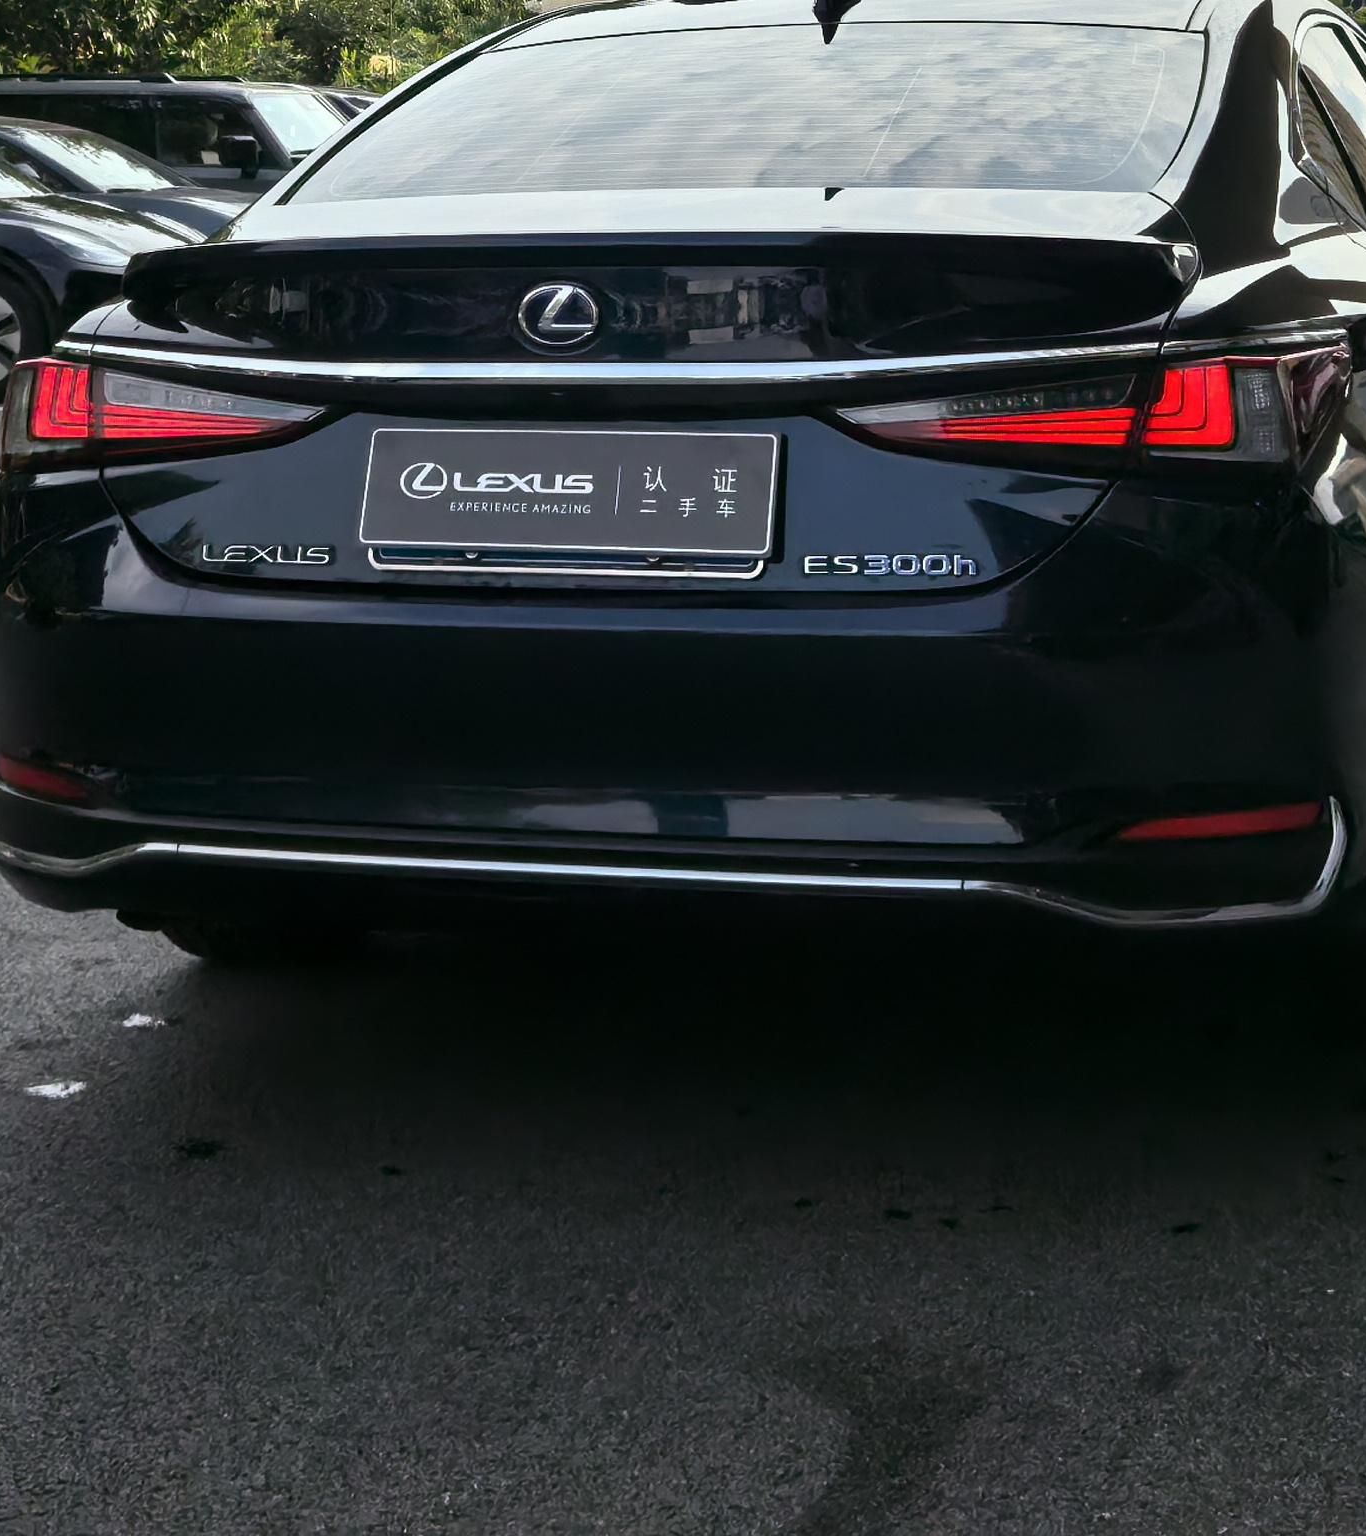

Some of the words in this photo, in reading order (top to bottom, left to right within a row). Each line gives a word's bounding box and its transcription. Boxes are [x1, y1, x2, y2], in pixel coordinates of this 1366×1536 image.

[453, 471, 595, 494] LEXUS
[642, 465, 738, 493] 认证
[449, 501, 528, 513] EXPERIENCE
[532, 503, 592, 515] AMAZING
[639, 497, 737, 518] 二手车
[202, 544, 331, 565] LEXUS
